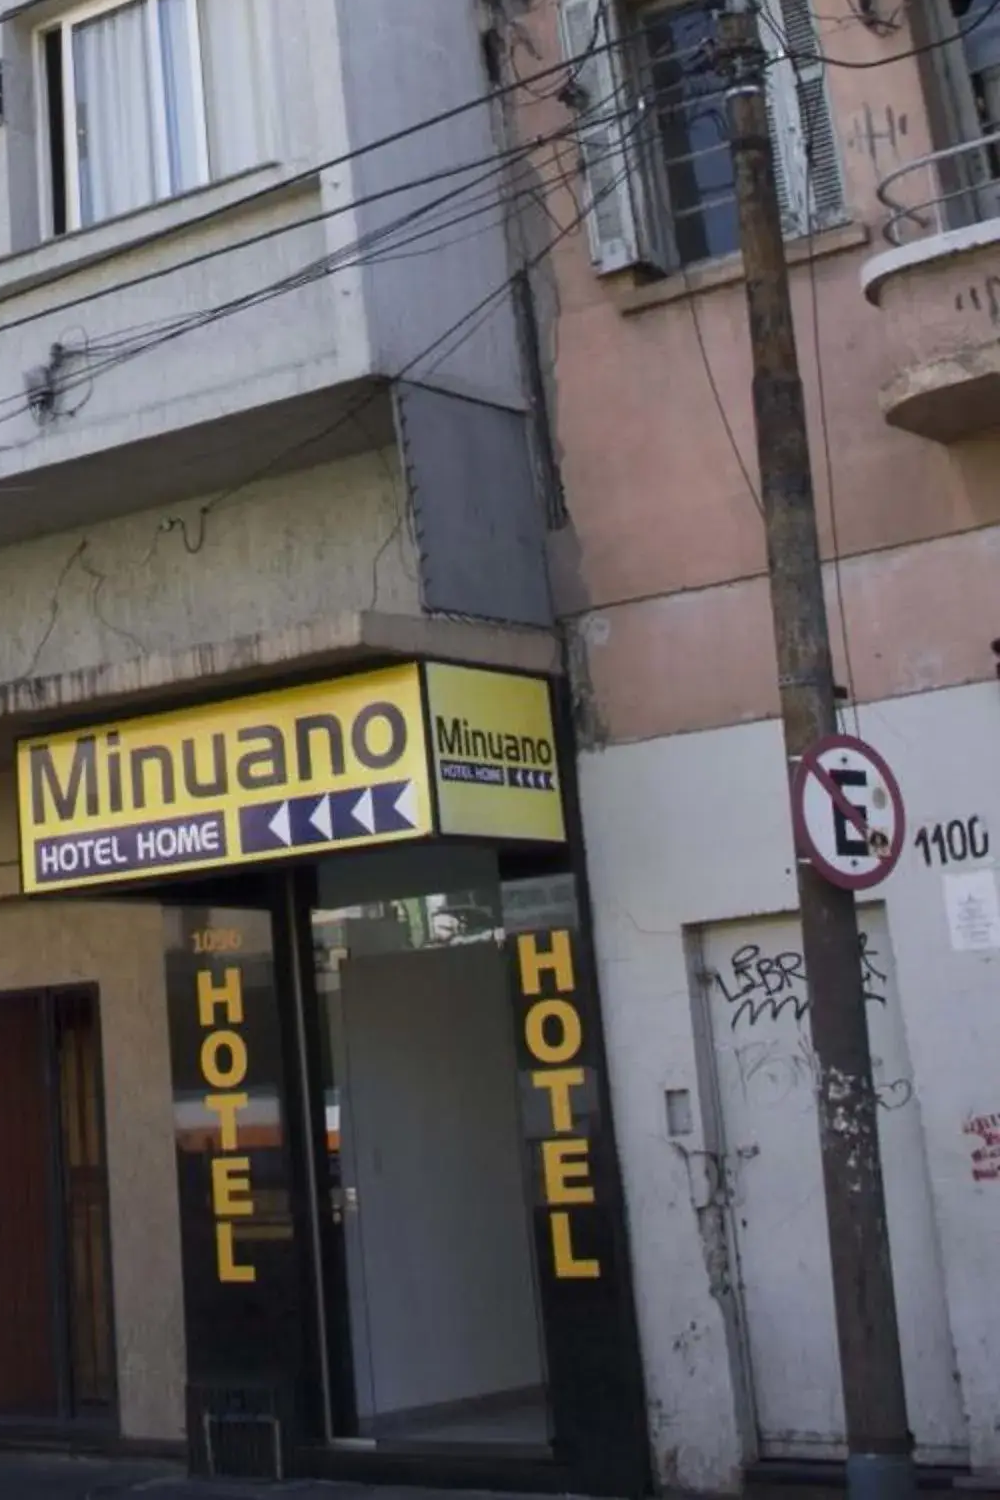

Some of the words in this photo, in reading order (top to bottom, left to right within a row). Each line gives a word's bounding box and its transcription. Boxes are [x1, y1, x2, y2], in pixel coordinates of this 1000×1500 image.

[29, 700, 409, 826] Minuano
[436, 715, 553, 766] Minuano
[41, 835, 127, 874] HOTEL
[137, 820, 221, 862] HOME
[196, 968, 256, 1282] HOTEL
[516, 929, 601, 1279] HOTEL
